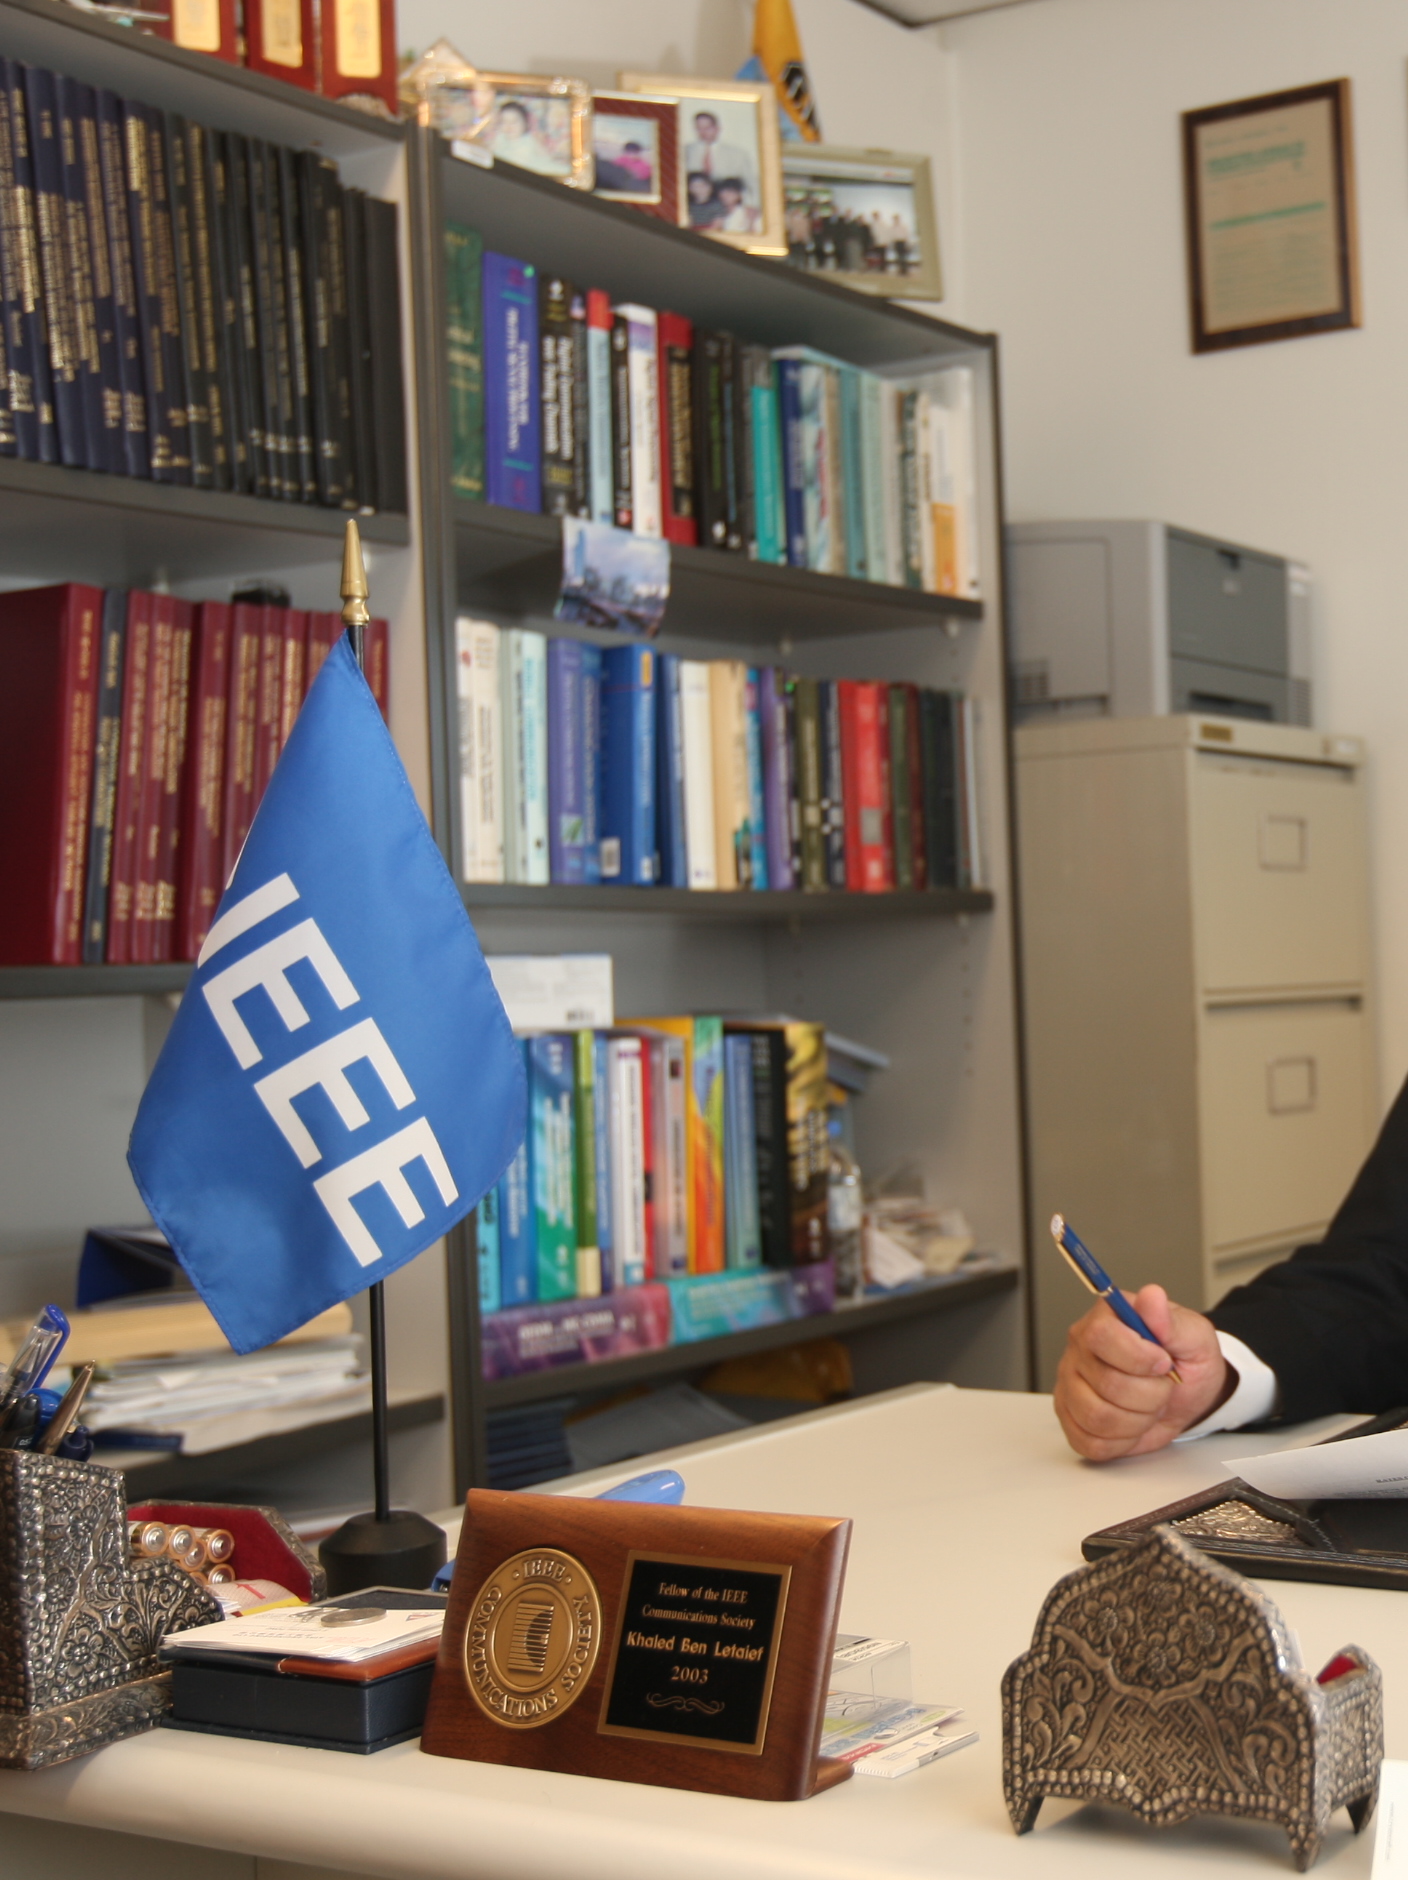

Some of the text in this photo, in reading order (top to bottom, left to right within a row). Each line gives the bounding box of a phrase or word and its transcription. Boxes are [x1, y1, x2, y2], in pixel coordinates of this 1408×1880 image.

[197, 871, 460, 1269] IEEE
[522, 1559, 566, 1583] IEEE
[658, 1582, 748, 1604] Fellow of the IEEE
[642, 1604, 756, 1630] Communications Society
[471, 1586, 593, 1718] COMMUNICATIONS SOCIETY
[626, 1631, 765, 1662] Khaled Ben Letaief
[671, 1665, 709, 1684] 2003
